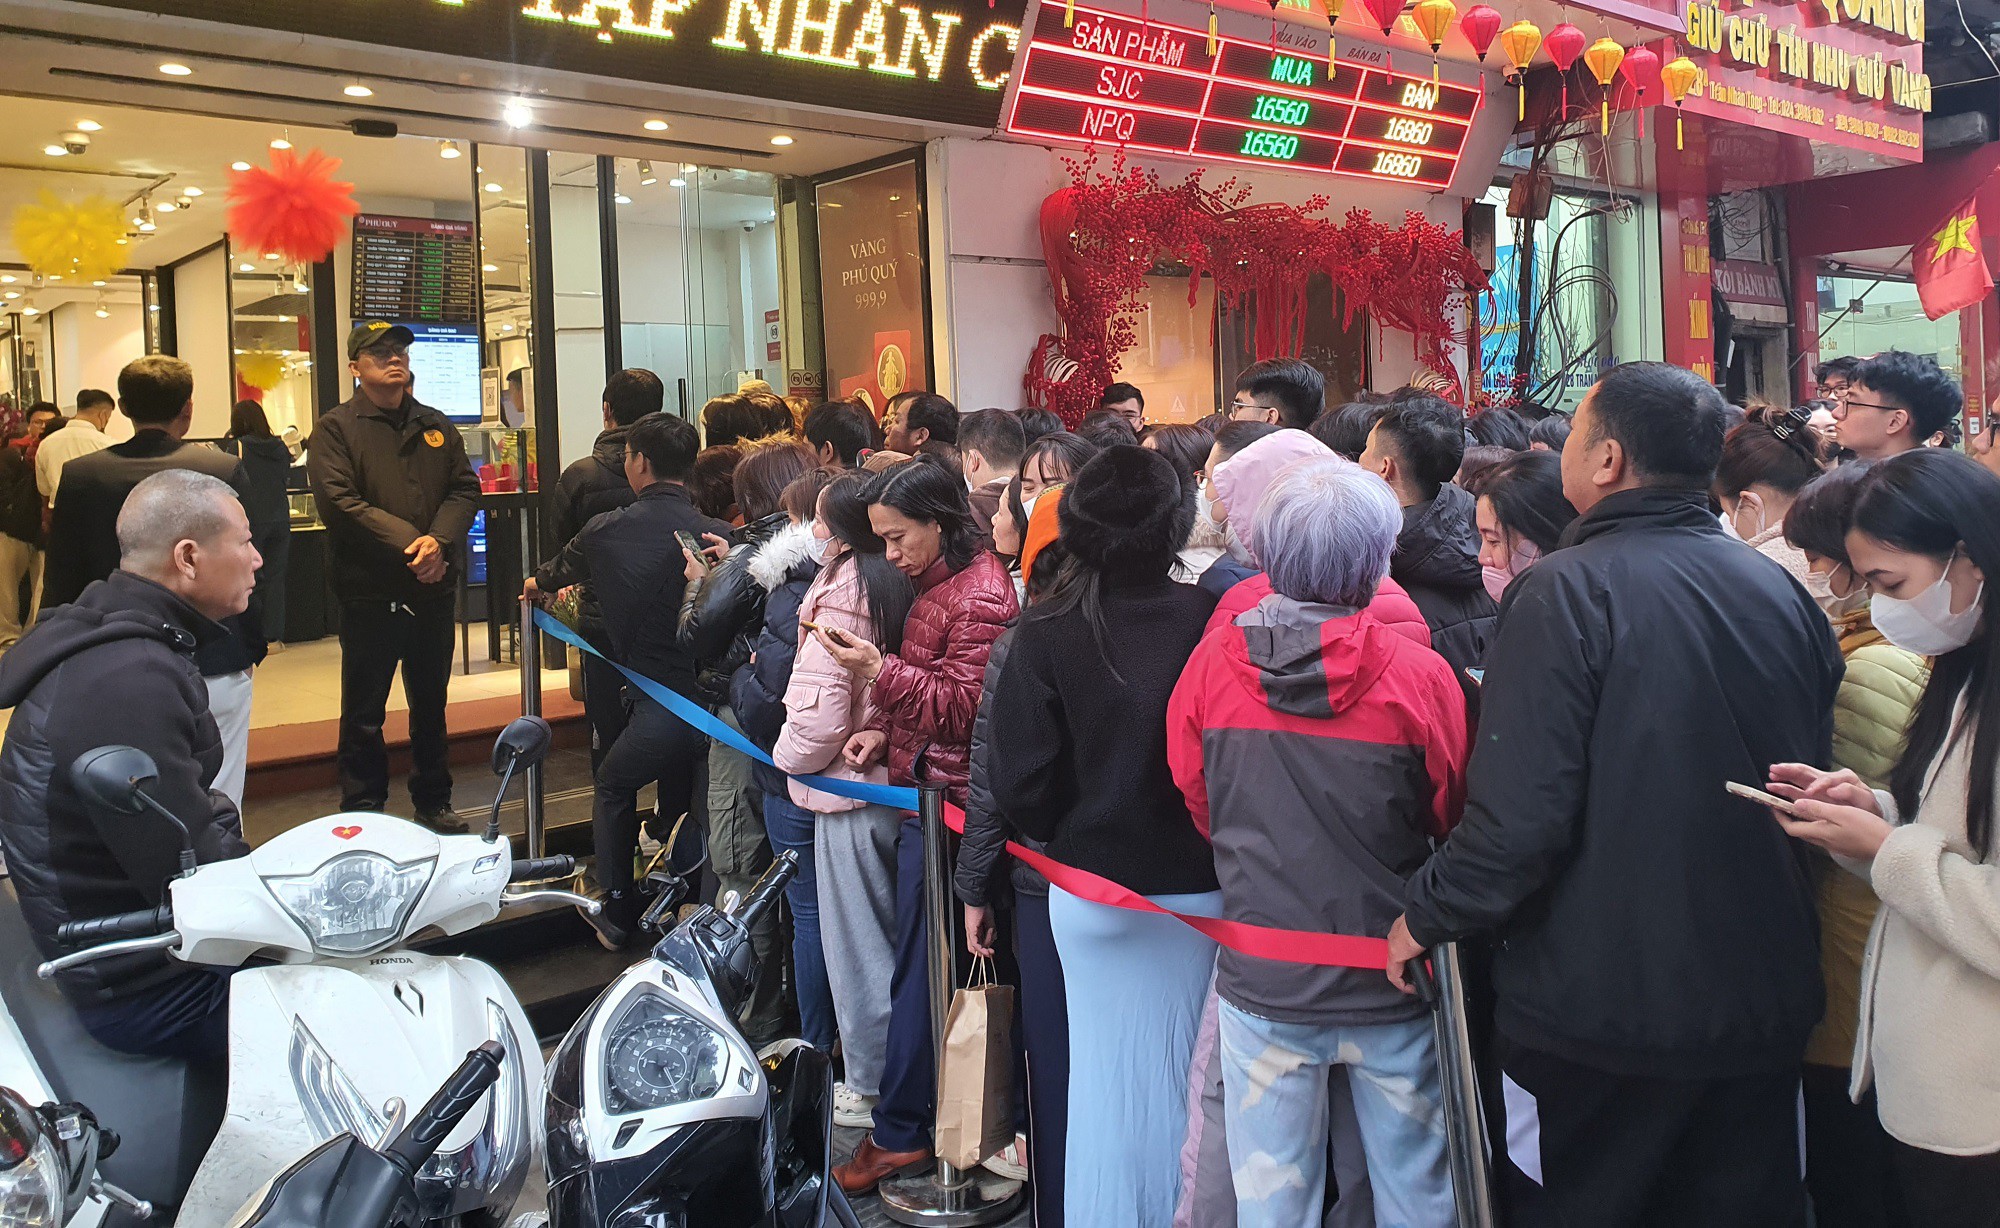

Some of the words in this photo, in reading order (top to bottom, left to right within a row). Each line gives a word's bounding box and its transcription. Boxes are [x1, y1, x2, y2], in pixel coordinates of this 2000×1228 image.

[1072, 16, 1121, 55] SẢN
[1123, 30, 1186, 67] PHẨM
[1347, 46, 1368, 60] BÁN
[1369, 51, 1382, 63] RA
[1097, 66, 1144, 99] SJC
[1270, 55, 1312, 87] MUA
[1251, 94, 1309, 126] 16560
[1401, 81, 1437, 111] BÁN
[1081, 106, 1136, 140] NPQ
[1383, 116, 1433, 145] 16860
[1239, 131, 1298, 160] 16560
[1371, 151, 1422, 178] 16860
[850, 237, 886, 259] VÀNG
[842, 263, 868, 287] PHÚ
[870, 258, 898, 285] QUÝ
[855, 289, 887, 310] 999,9
[369, 957, 414, 965] HONDA
